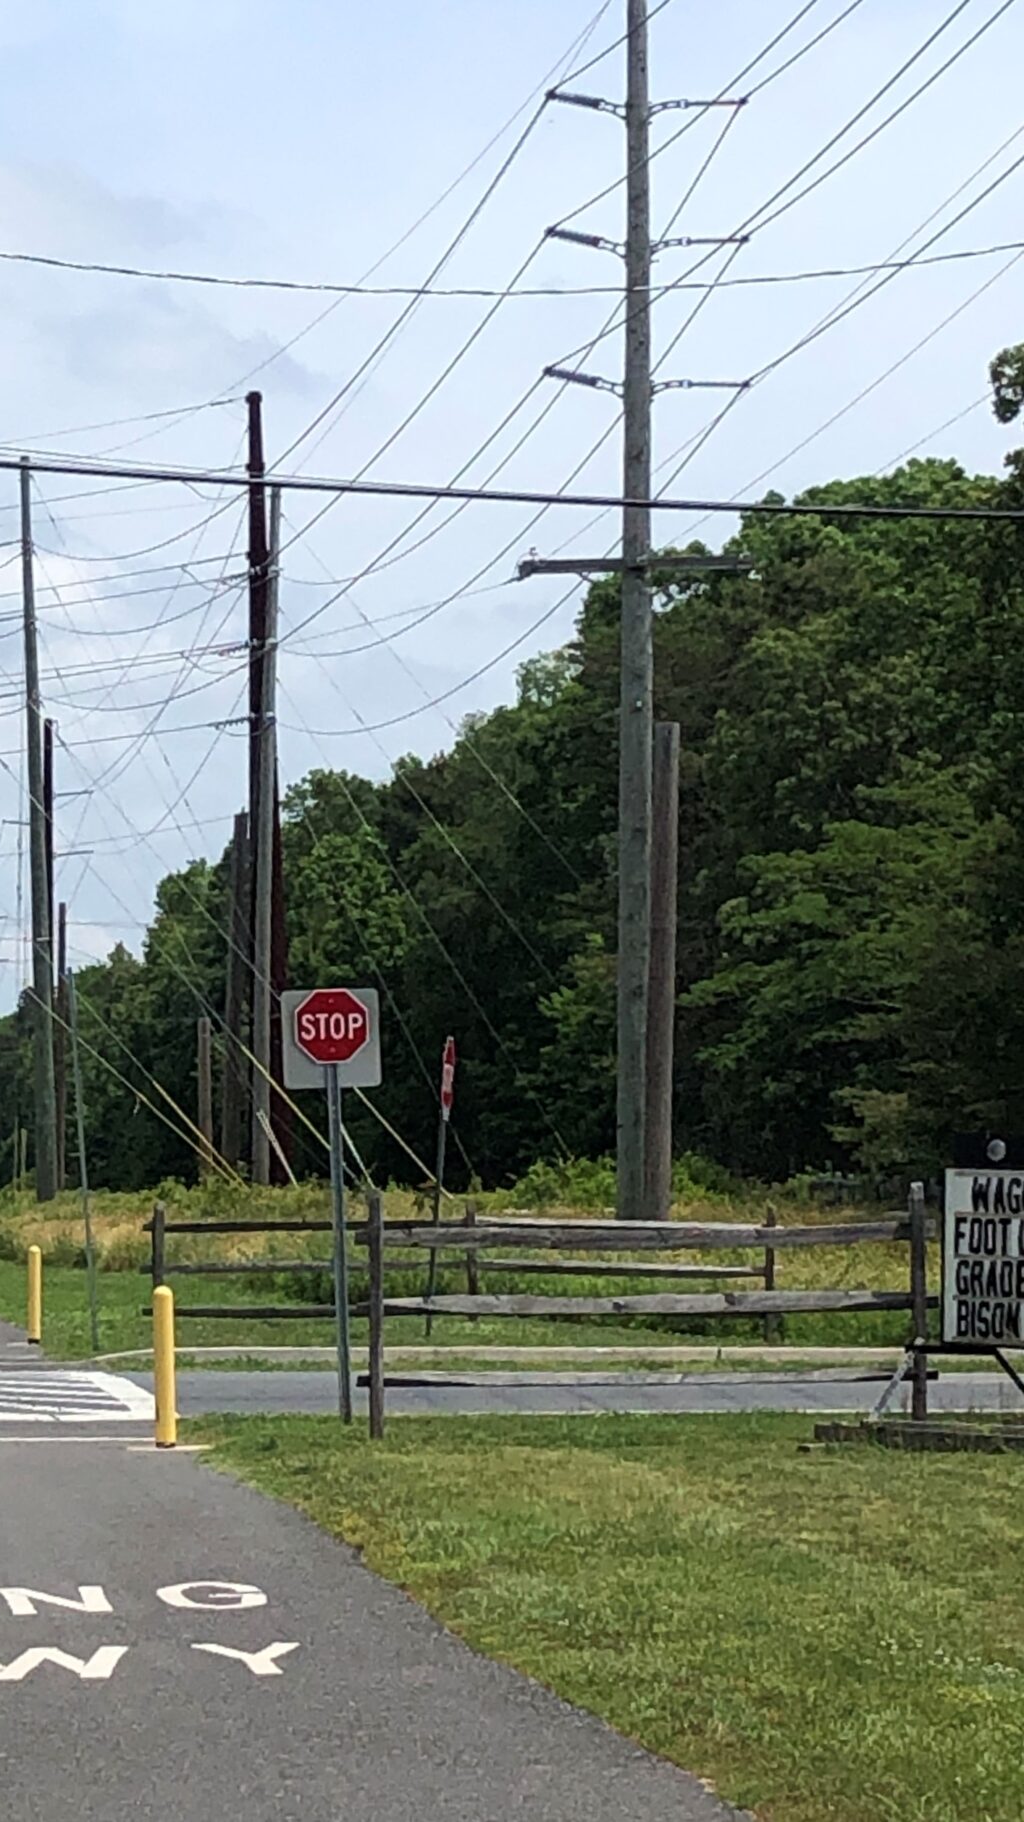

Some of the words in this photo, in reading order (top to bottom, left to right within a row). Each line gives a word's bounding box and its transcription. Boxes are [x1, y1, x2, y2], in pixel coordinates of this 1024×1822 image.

[301, 1013, 363, 1041] STOP
[971, 1176, 1024, 1214] WAG
[955, 1217, 1011, 1257] FOOT
[957, 1301, 1021, 1339] BISON
